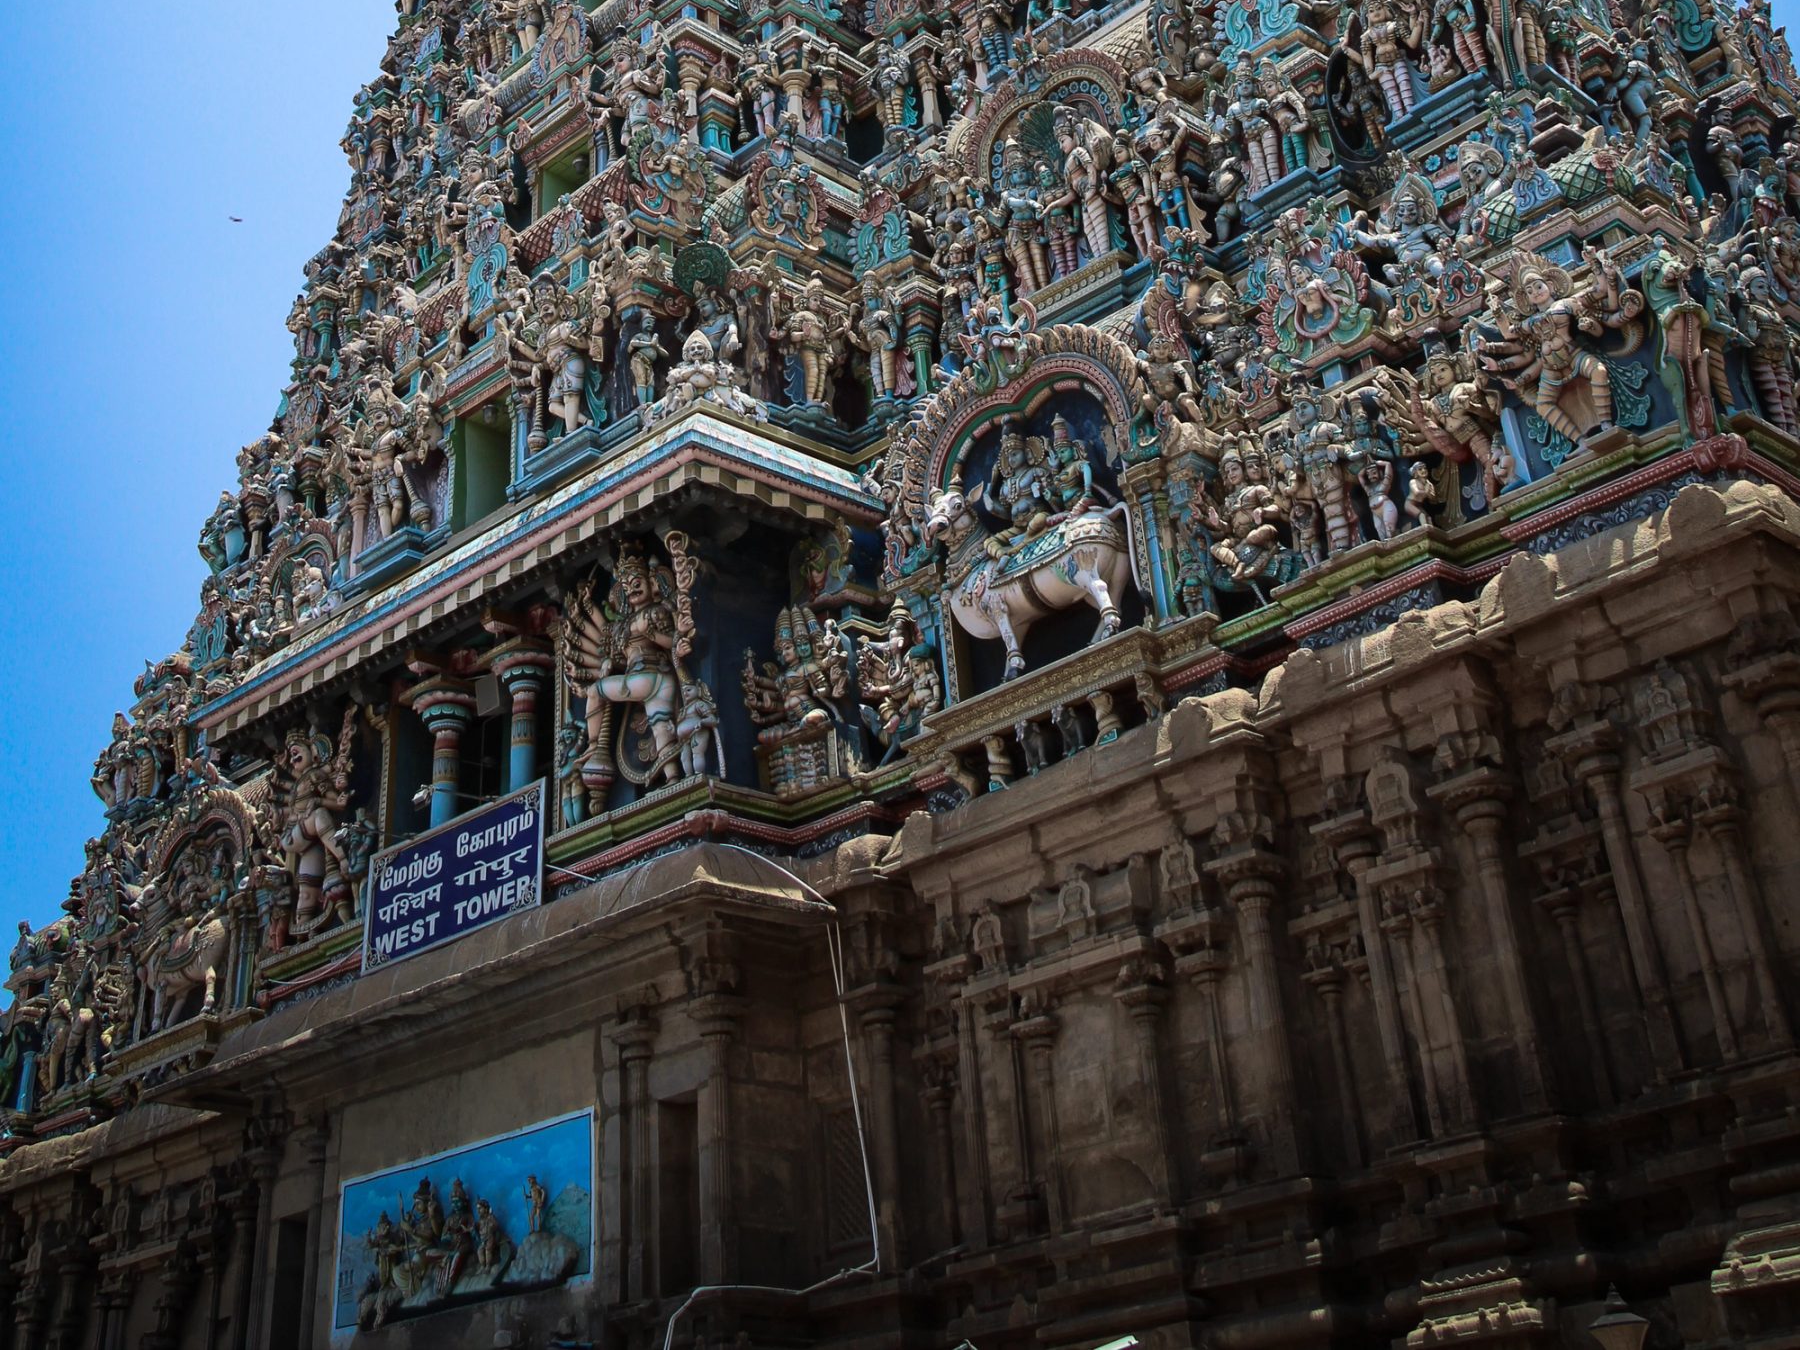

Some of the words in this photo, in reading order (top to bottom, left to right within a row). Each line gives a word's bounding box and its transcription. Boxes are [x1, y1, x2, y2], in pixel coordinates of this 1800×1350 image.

[378, 882, 443, 924] पश्चिम
[453, 844, 533, 886] गोपुर
[380, 850, 443, 891] மேற்கு
[456, 805, 534, 858] கோபுரம்
[375, 911, 441, 954] WEST
[453, 874, 531, 926] TOWER
